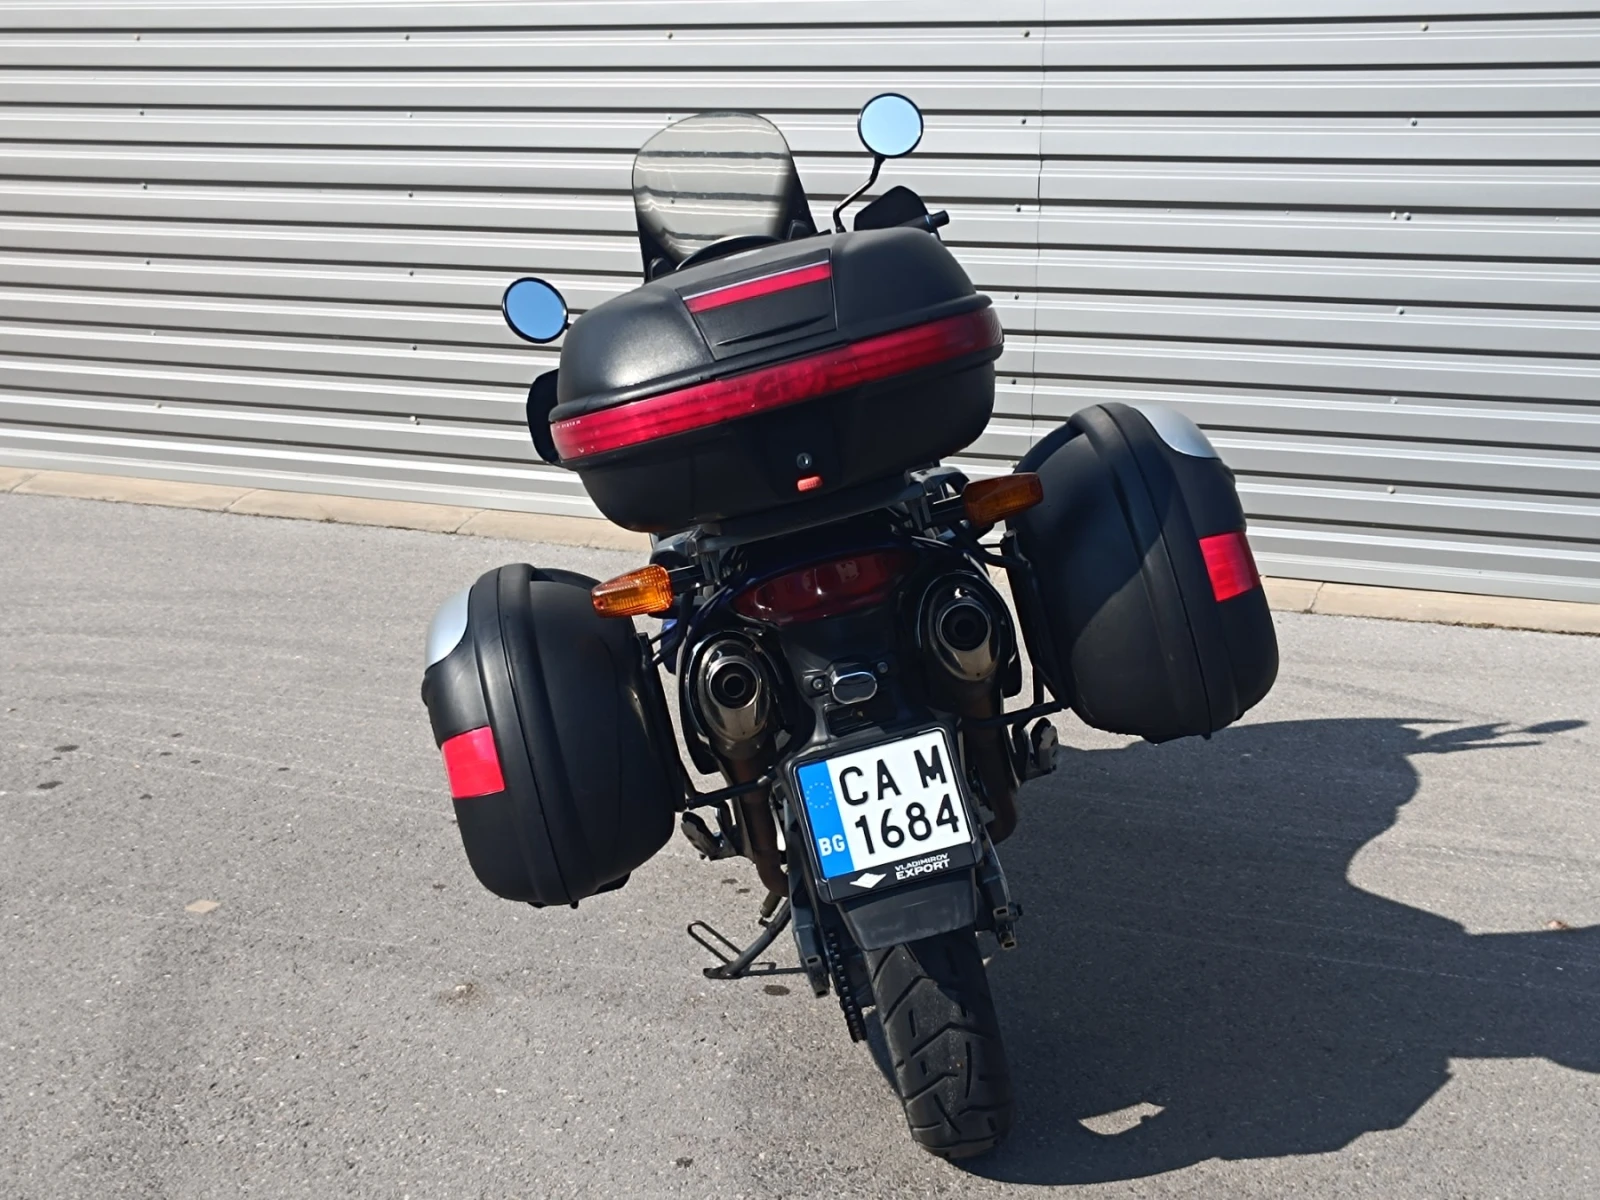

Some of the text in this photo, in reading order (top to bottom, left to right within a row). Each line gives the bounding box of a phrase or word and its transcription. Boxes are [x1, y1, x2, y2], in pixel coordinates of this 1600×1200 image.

[839, 745, 947, 806] CA M
[855, 793, 959, 855] 1684
[818, 834, 846, 856] BG
[895, 852, 948, 871] VLADIMIROV
[896, 858, 950, 880] EXPORT
